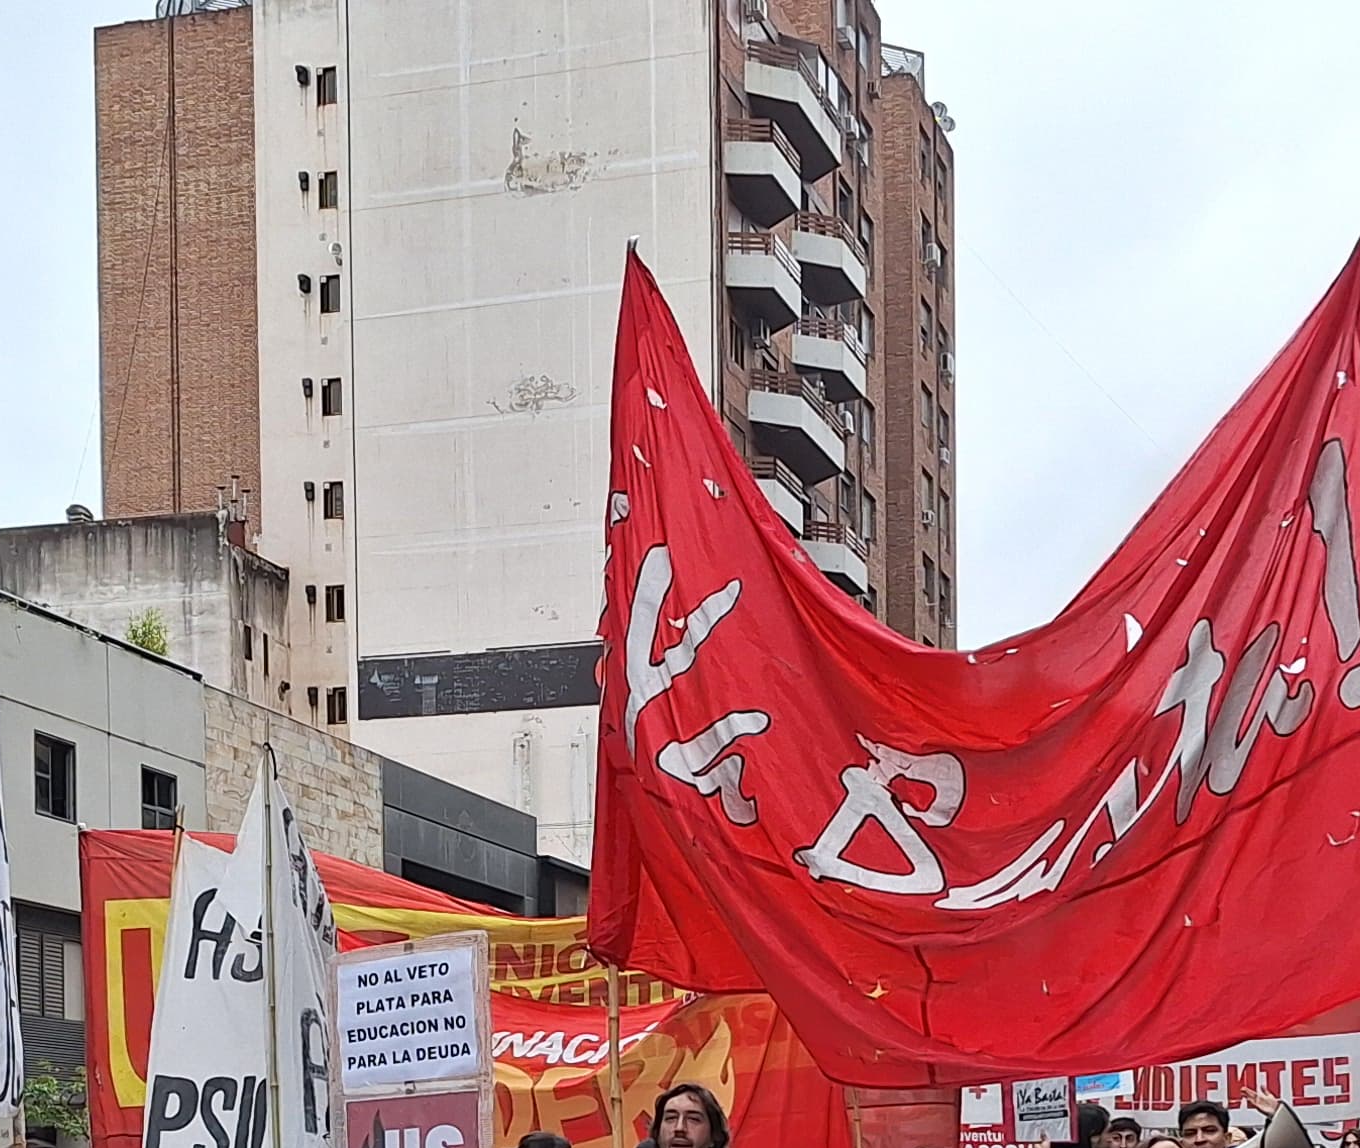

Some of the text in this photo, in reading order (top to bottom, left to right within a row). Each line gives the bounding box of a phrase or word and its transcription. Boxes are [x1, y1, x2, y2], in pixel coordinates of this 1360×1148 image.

[357, 962, 450, 988] NO AL VETO
[356, 989, 454, 1016] PLATA PARA
[347, 1014, 467, 1043] EDUCACION NO
[347, 1042, 471, 1070] PARA LA DEUDA
[1034, 1085, 1067, 1104] Basta!
